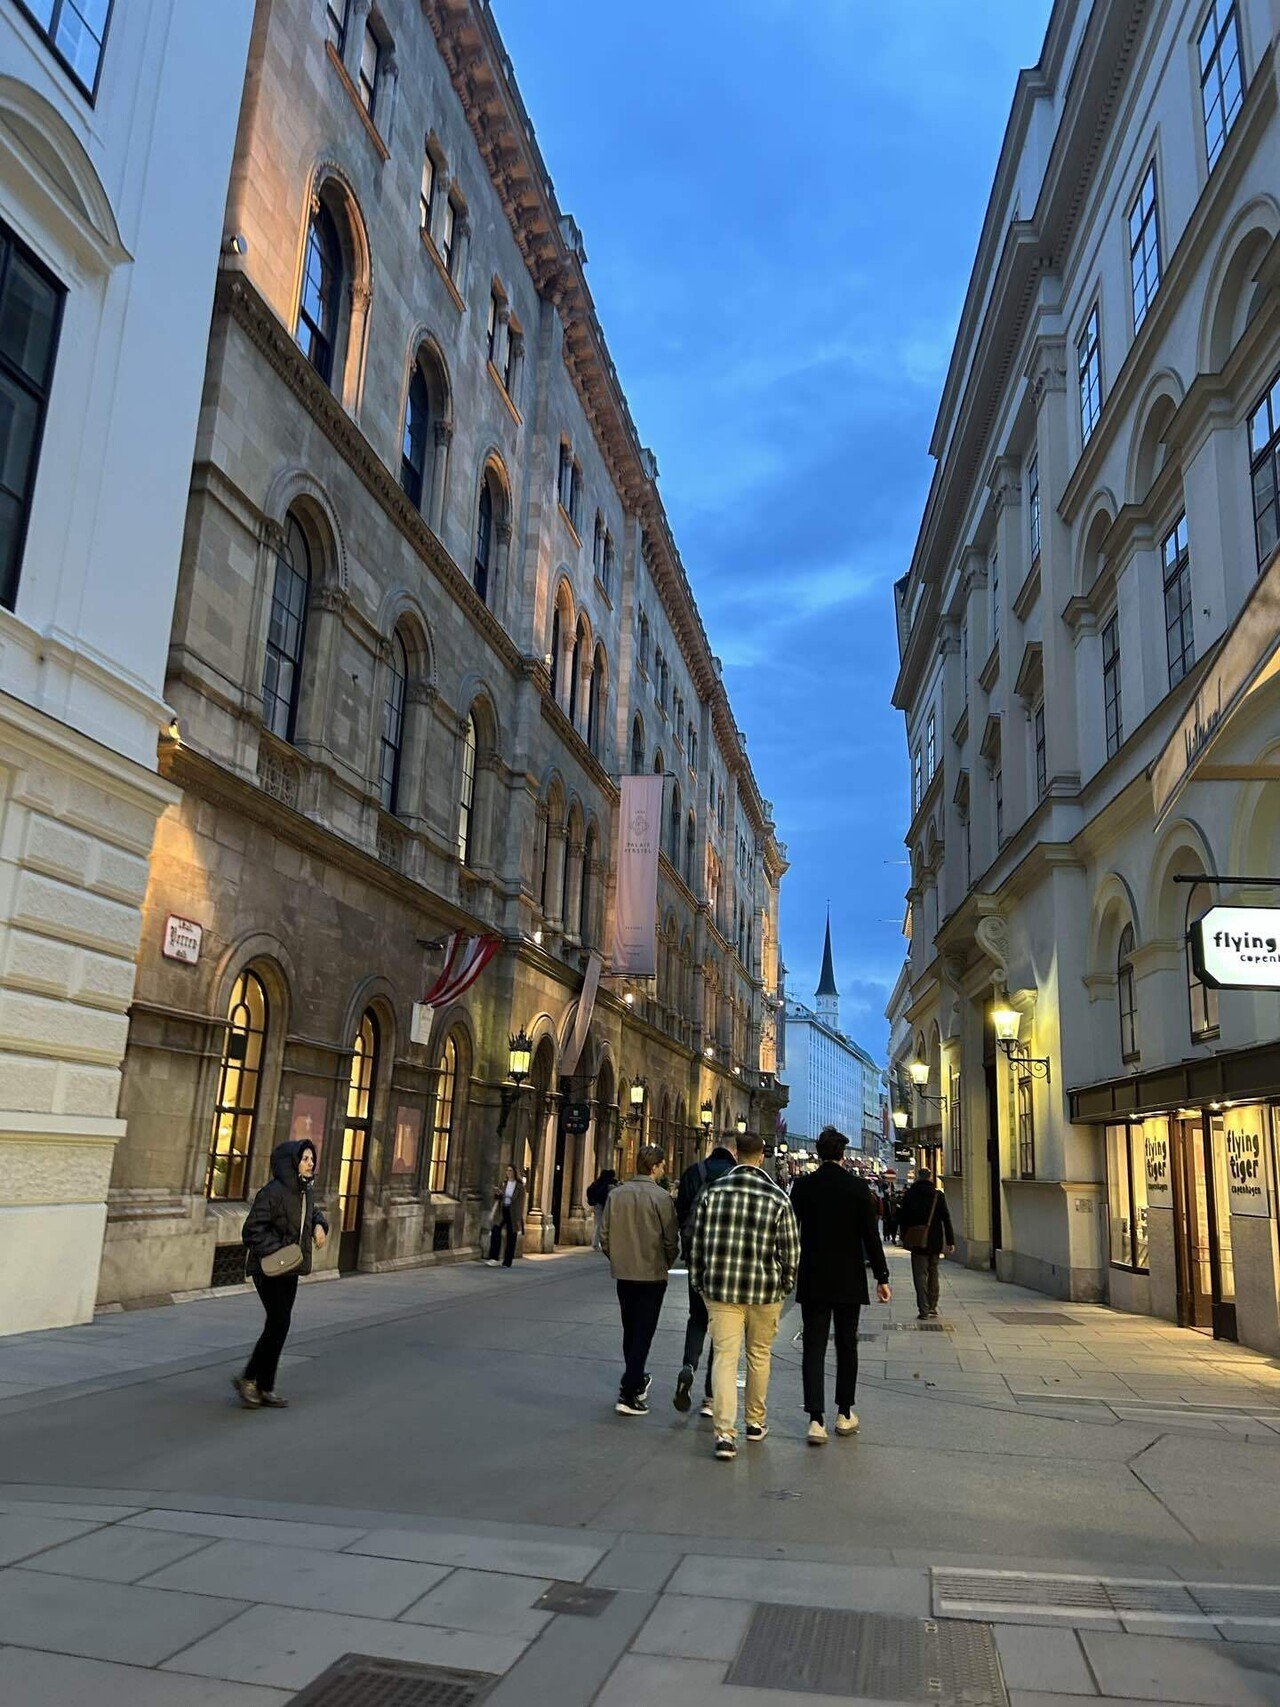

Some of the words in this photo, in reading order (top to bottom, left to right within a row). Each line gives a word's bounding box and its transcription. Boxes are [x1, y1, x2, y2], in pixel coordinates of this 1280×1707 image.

[1213, 931, 1277, 953] flying
[1145, 1135, 1167, 1162] flying
[1226, 1128, 1260, 1159] flying
[1147, 1159, 1166, 1182] tiger
[1229, 1154, 1259, 1184] tiger
[1231, 1185, 1261, 1197] copenhagen
